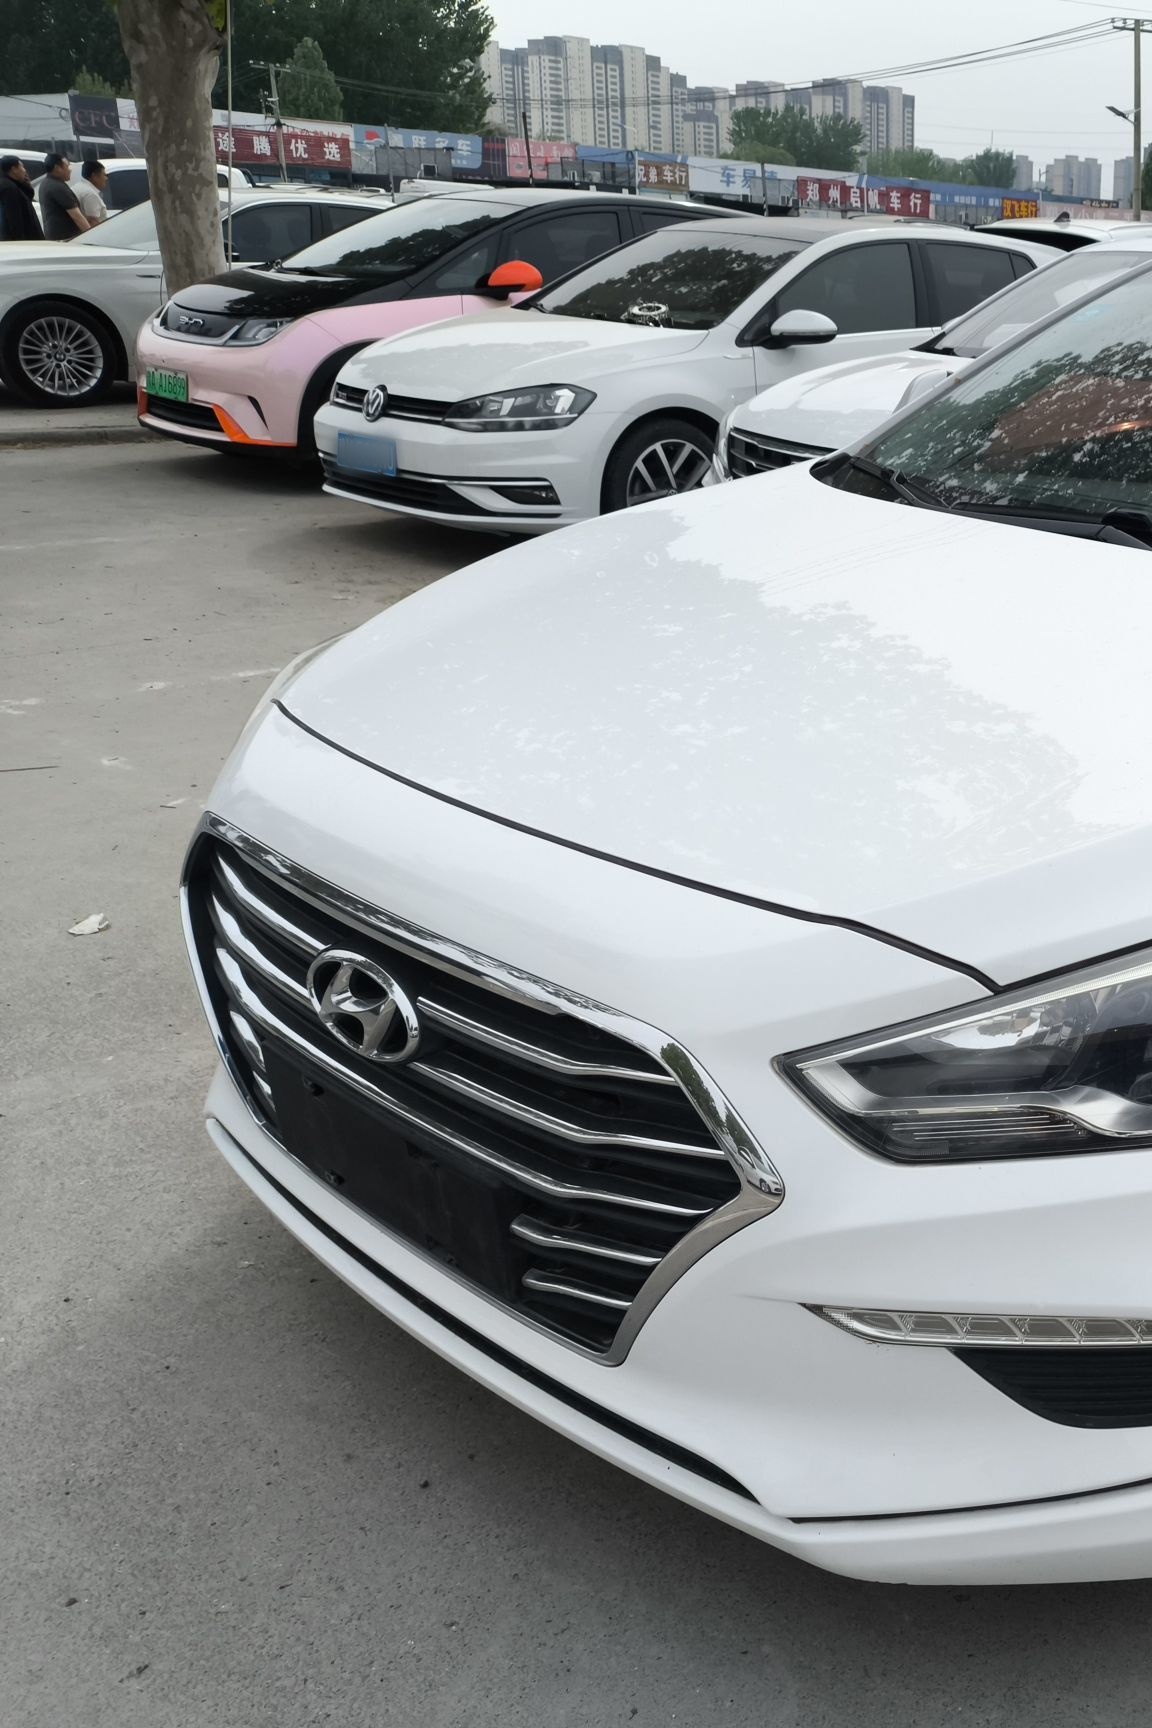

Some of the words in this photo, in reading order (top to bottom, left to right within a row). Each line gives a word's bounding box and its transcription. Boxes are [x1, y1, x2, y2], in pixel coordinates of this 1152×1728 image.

[216, 132, 342, 162] 途腾优选
[637, 164, 687, 185] 兄弟车行
[806, 181, 922, 214] 郑州启帆车行
[1003, 199, 1038, 218] 汉飞车行
